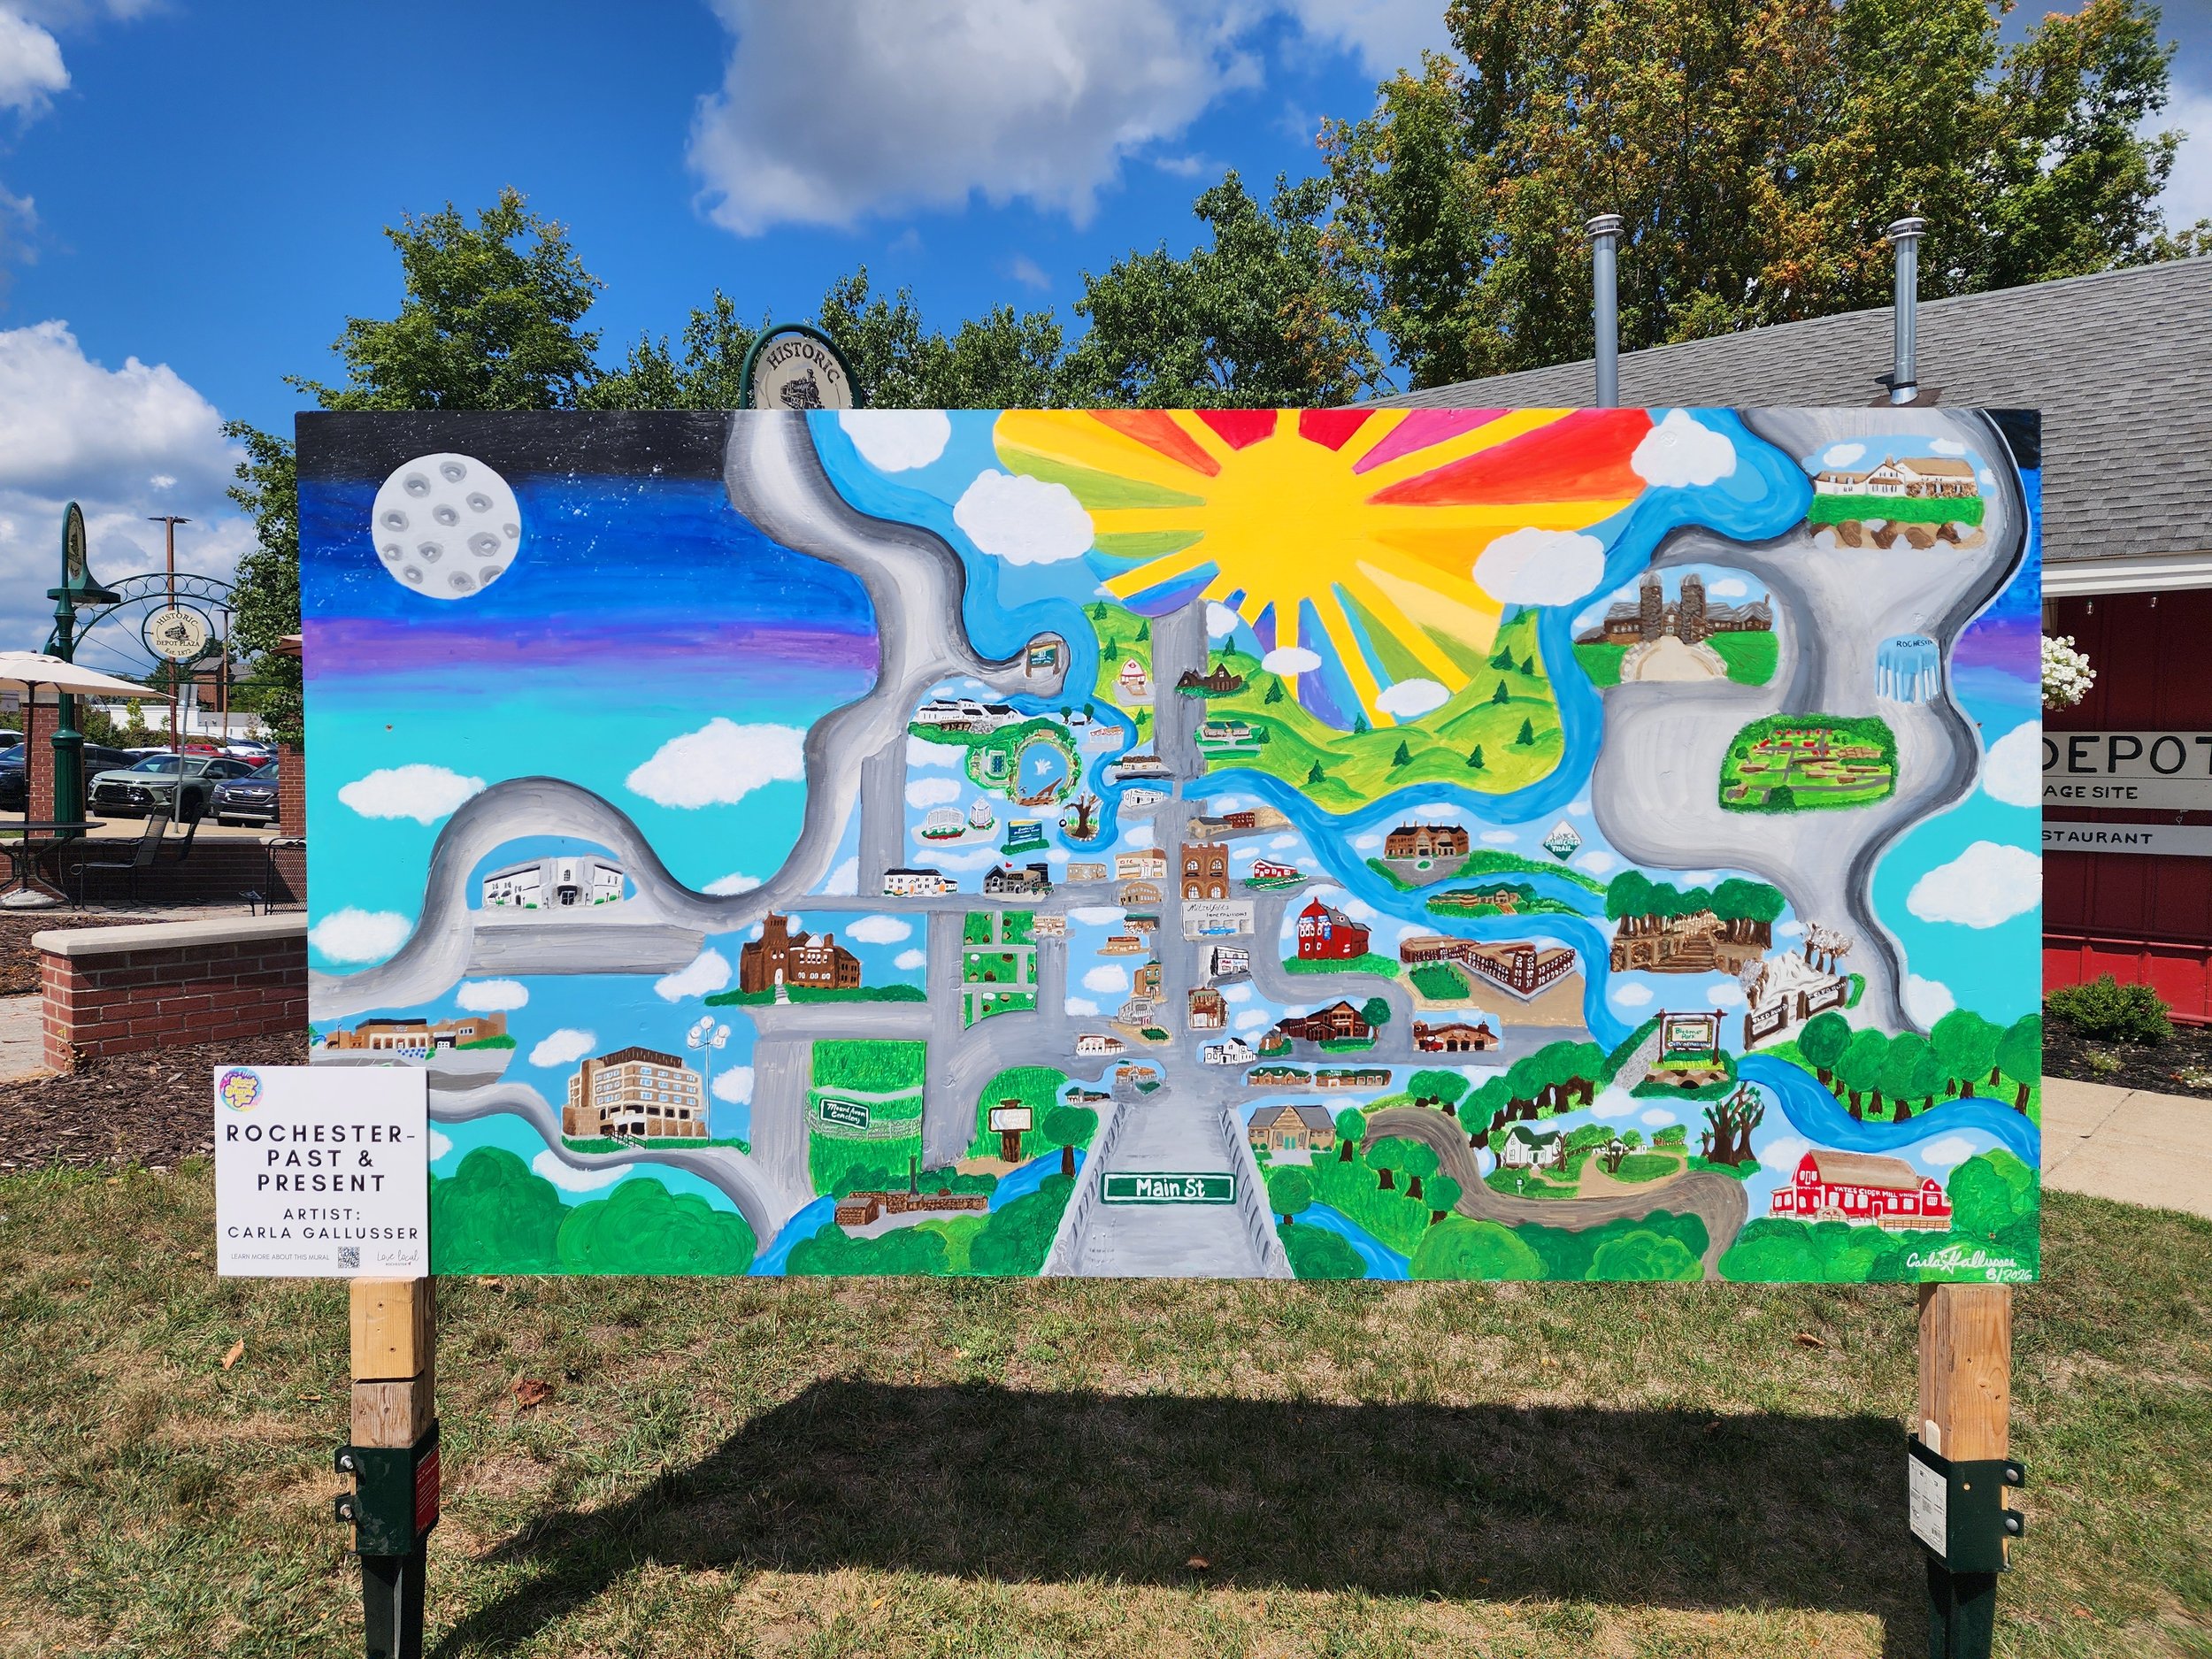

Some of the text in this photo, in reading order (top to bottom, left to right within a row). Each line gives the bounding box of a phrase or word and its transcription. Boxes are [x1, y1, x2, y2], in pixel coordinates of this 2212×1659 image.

[766, 342, 841, 384] HISTORIC
[157, 612, 198, 626] HISTORIC
[2092, 787, 2138, 799] SITE
[2042, 830, 2153, 844] STAURANT
[227, 1124, 415, 1142] ROCHESTER-
[267, 1149, 373, 1167] PAST &
[257, 1174, 384, 1192] PRESENT
[1136, 1178, 1205, 1197] Main St
[283, 1209, 360, 1220] ARTIST:
[227, 1226, 418, 1240] CARLA GALLUSSER
